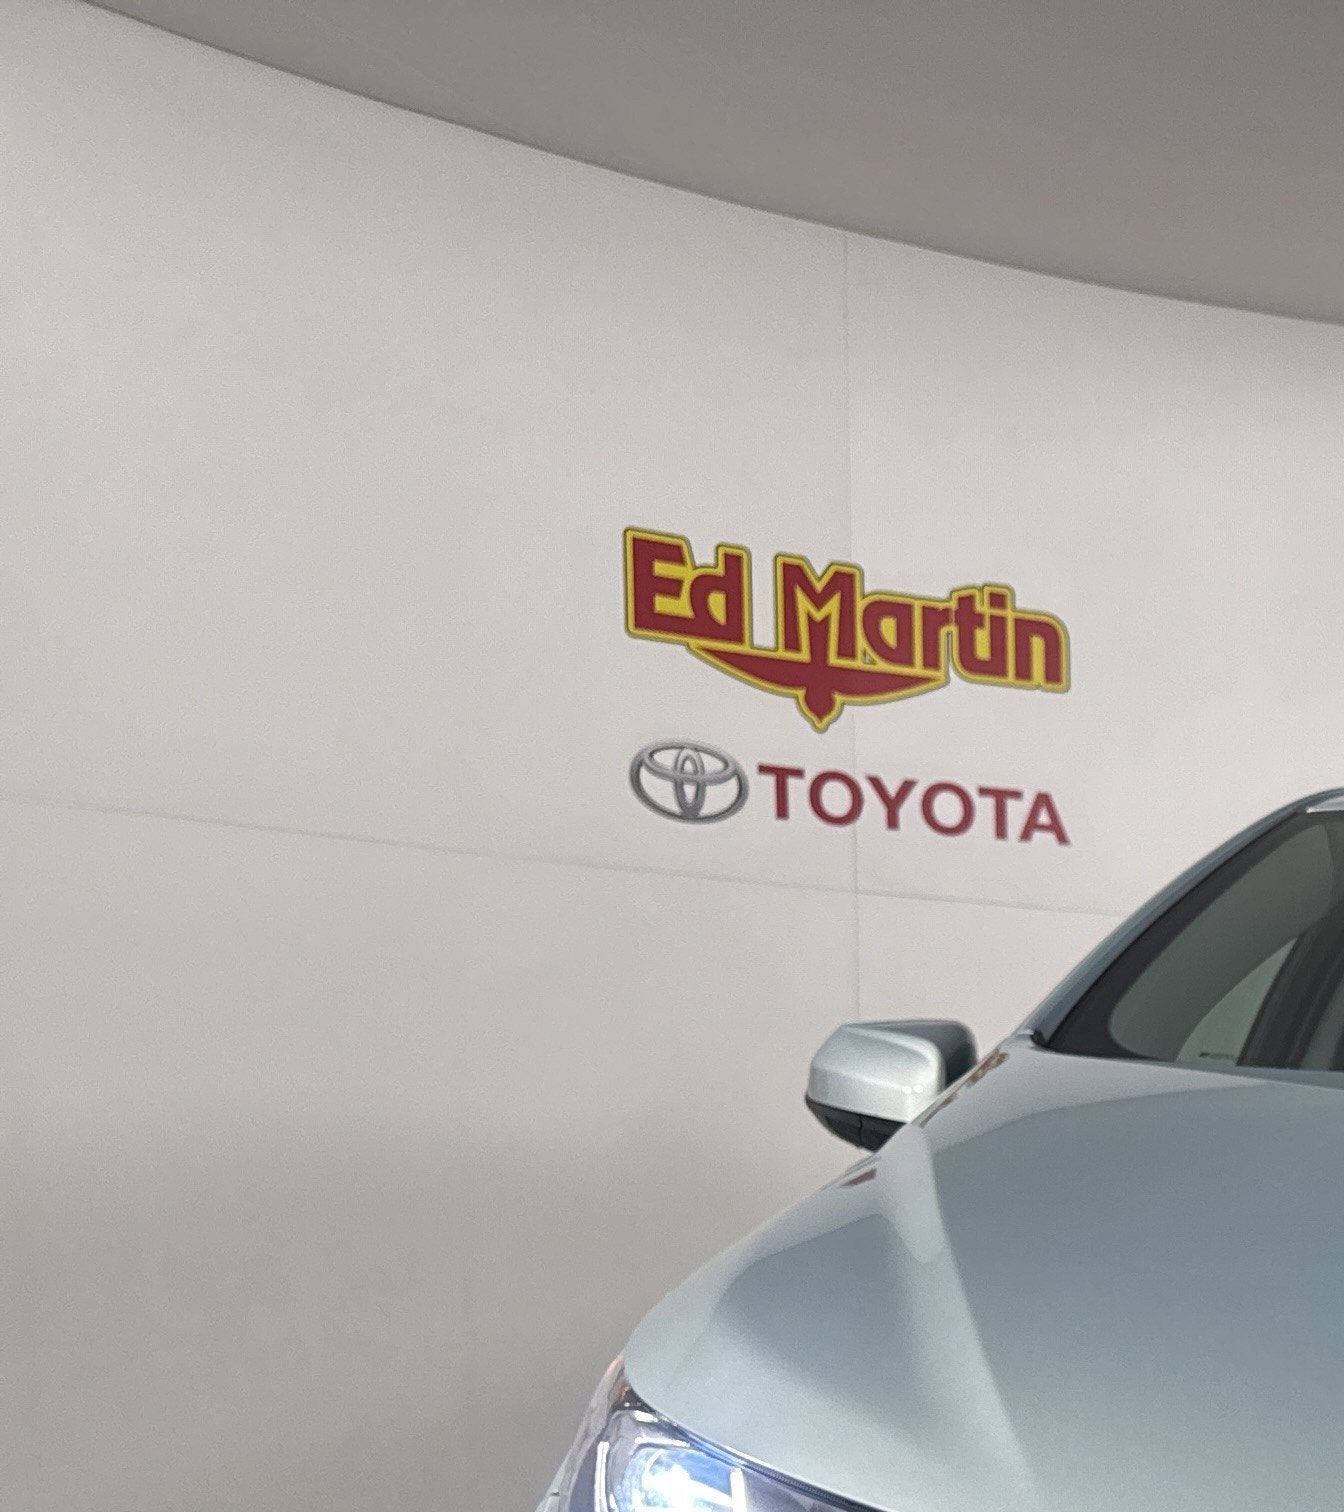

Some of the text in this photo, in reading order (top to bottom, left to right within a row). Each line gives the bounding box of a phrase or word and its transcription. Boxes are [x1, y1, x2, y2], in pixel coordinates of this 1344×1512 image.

[627, 532, 1067, 690] Ed Martin
[757, 763, 1071, 846] TOYOTA
